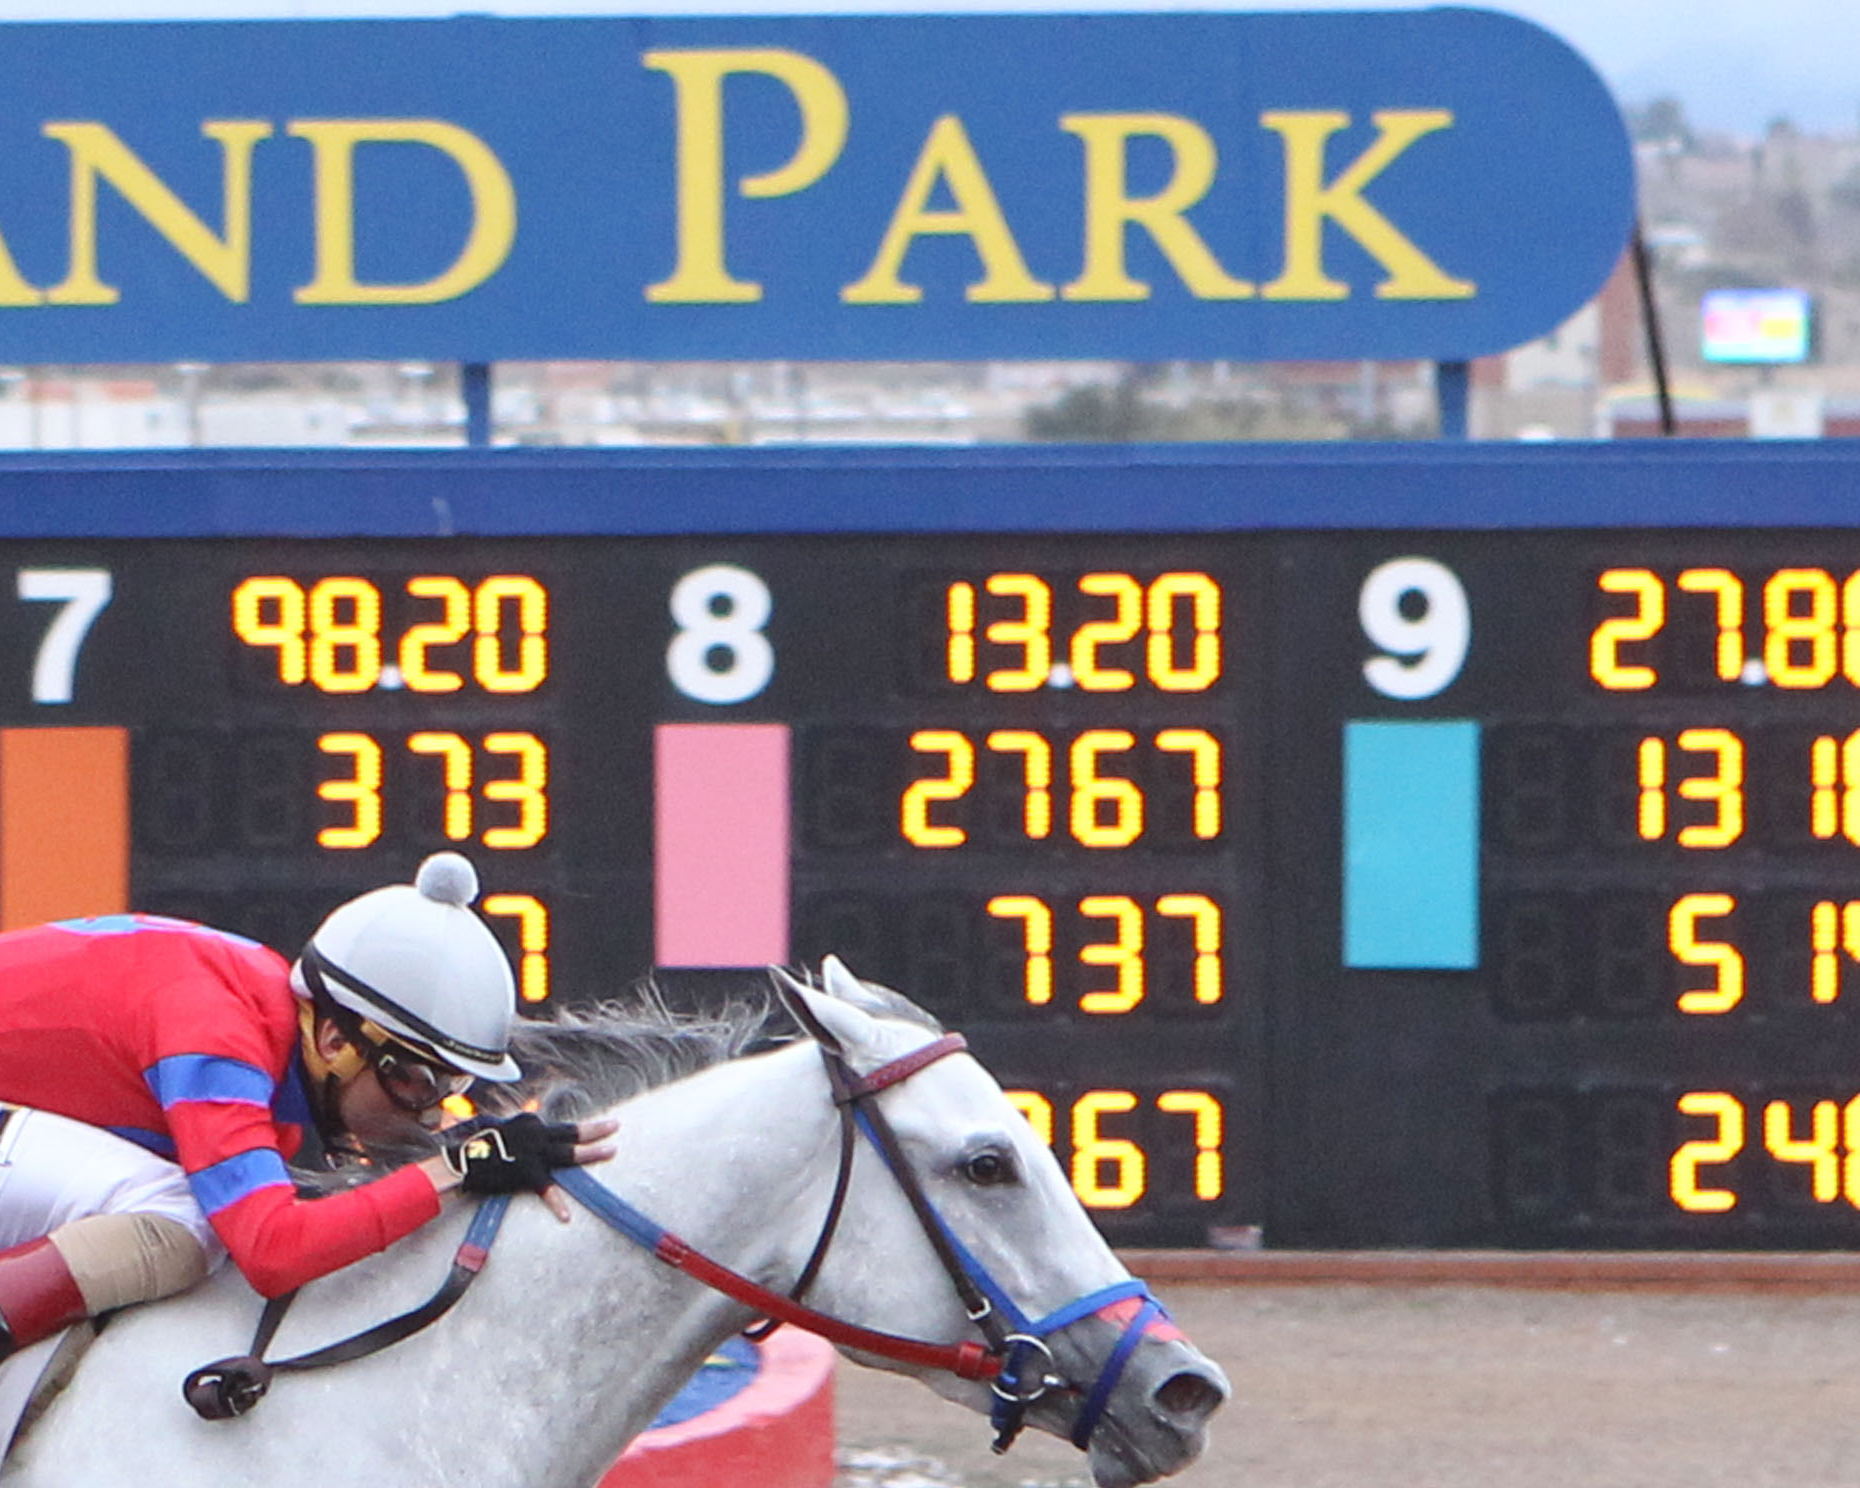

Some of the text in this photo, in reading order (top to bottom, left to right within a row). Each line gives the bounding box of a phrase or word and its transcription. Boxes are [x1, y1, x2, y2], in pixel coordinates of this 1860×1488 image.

[645, 47, 1478, 304] PARK
[16, 568, 113, 705] 7
[230, 574, 549, 695] 98.20
[665, 564, 776, 705] 8
[946, 571, 1222, 693] 13.20
[1357, 557, 1471, 700] 9
[1589, 566, 1860, 690] 27.8
[315, 730, 549, 850] 373
[899, 728, 1222, 849] 2767
[1637, 727, 1860, 849] 131
[985, 894, 1223, 1015] 737
[1667, 892, 1860, 1015] 51
[1668, 1090, 1860, 1213] 24
